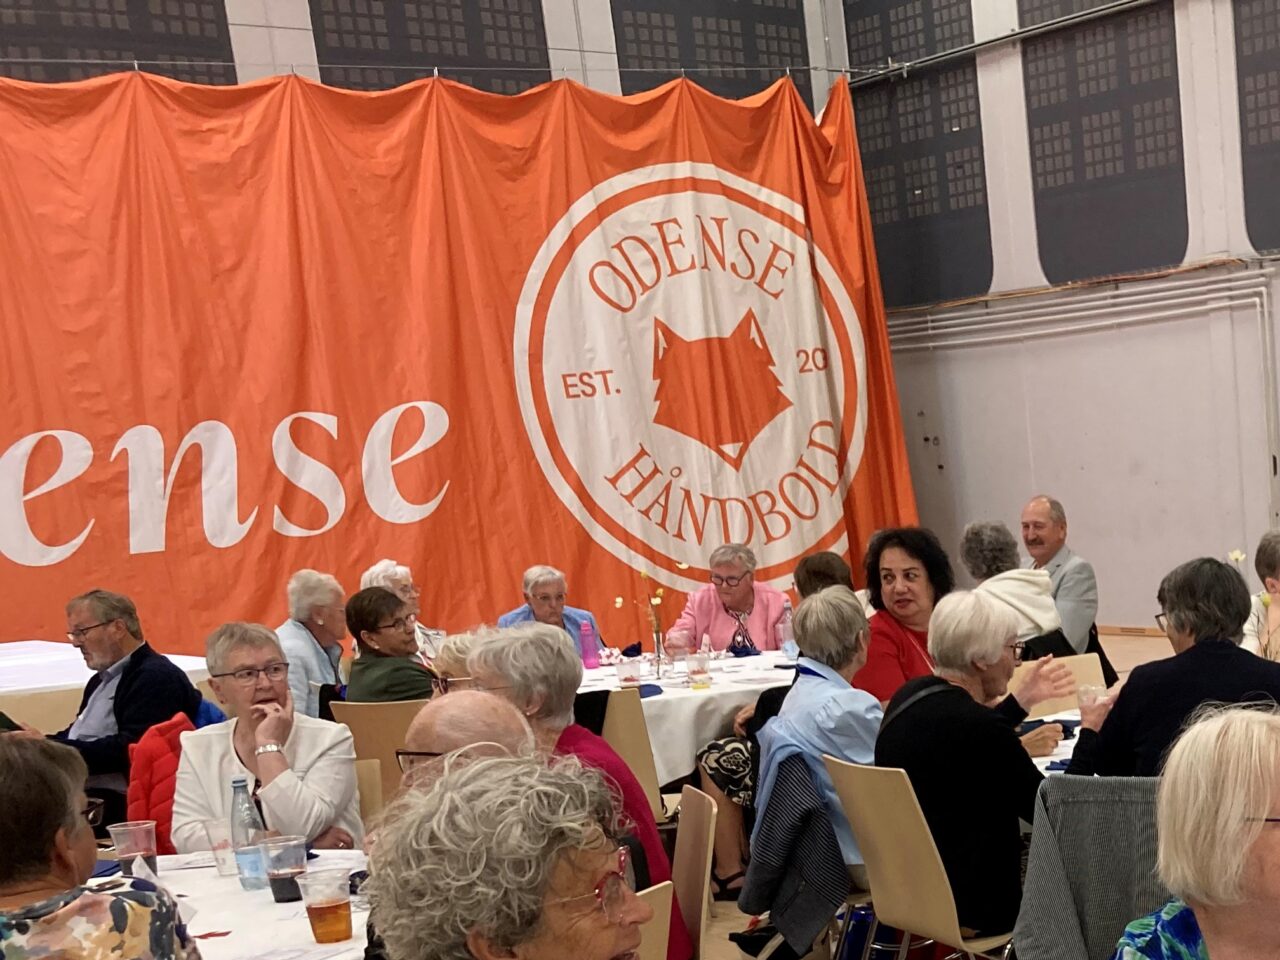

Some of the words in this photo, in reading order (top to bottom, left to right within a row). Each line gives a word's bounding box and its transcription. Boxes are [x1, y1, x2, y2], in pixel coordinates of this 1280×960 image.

[588, 214, 796, 314] ODENSE
[561, 370, 622, 400] EST.
[605, 420, 842, 545] HÅNDBOLD
